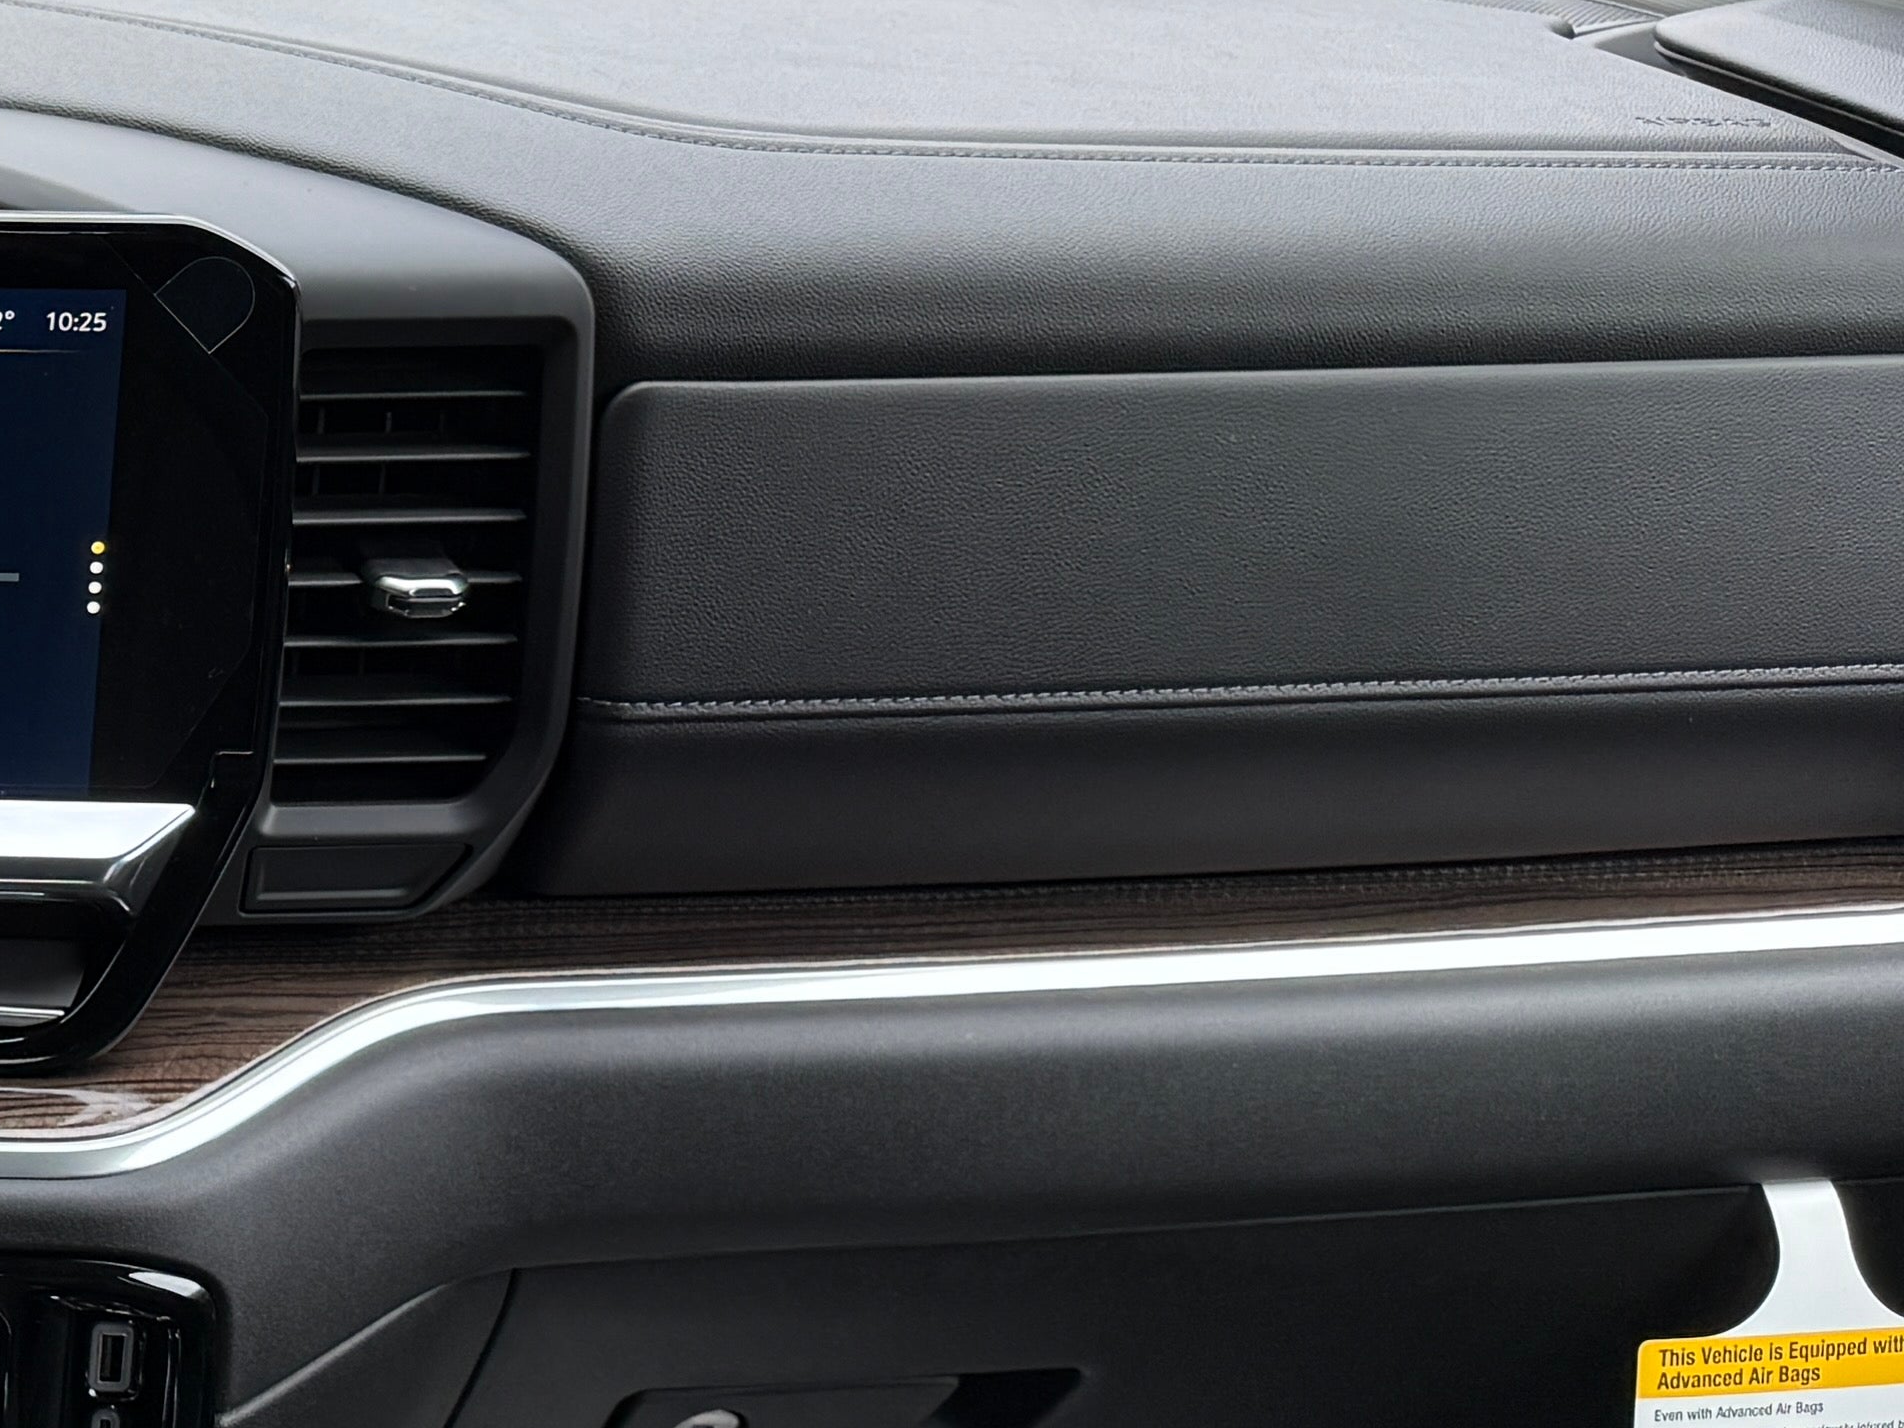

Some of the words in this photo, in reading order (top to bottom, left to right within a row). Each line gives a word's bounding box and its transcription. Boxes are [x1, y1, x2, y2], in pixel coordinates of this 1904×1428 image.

[46, 311, 108, 332] 10:25
[1659, 1347, 1696, 1367] This
[1701, 1344, 1764, 1365] Vehicle
[1769, 1342, 1783, 1361] is
[1789, 1337, 1868, 1362] Equipped
[1657, 1368, 1743, 1391] Advanced
[1748, 1366, 1774, 1385] Air
[1778, 1365, 1821, 1386] Bags
[1654, 1409, 1683, 1422] Even
[1687, 1408, 1713, 1420] with
[1716, 1403, 1772, 1419] Advanced
[1776, 1402, 1792, 1416] Air
[1796, 1401, 1824, 1416] Bags
